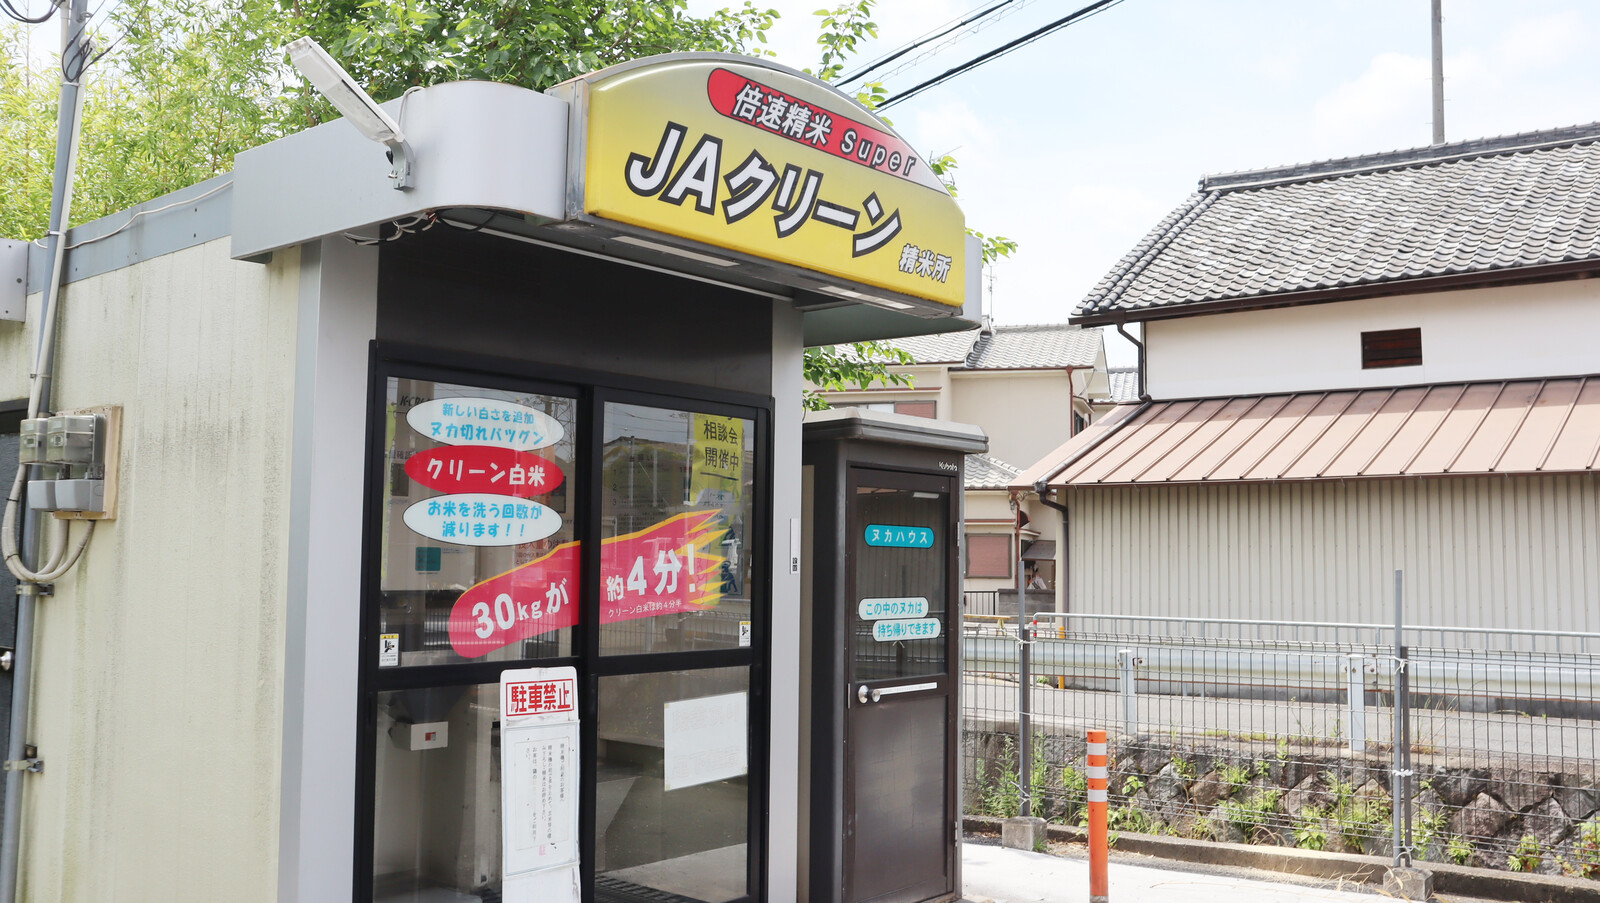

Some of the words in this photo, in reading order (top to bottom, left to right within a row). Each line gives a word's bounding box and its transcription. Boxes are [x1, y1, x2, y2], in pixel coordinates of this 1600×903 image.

[731, 81, 832, 146] 倍速精米
[840, 128, 917, 176] Super
[625, 121, 902, 258] JAクリーン
[899, 243, 952, 283] 精米所
[442, 403, 534, 424] 新しい白さを追加
[431, 422, 544, 445] ヌカ切れバツグン
[704, 420, 738, 445] 相談会
[705, 447, 739, 471] 開催中
[938, 461, 958, 471] Kubota
[427, 458, 545, 487] クリーン白米
[428, 501, 542, 520] お米を洗う回数が
[872, 529, 928, 544] ヌカハウス
[608, 599, 682, 618] クリーン白米は約4分半
[866, 602, 922, 615] この中のヌカは
[877, 622, 936, 638] 持ち帰りできます
[511, 682, 571, 713] 駐車禁止
